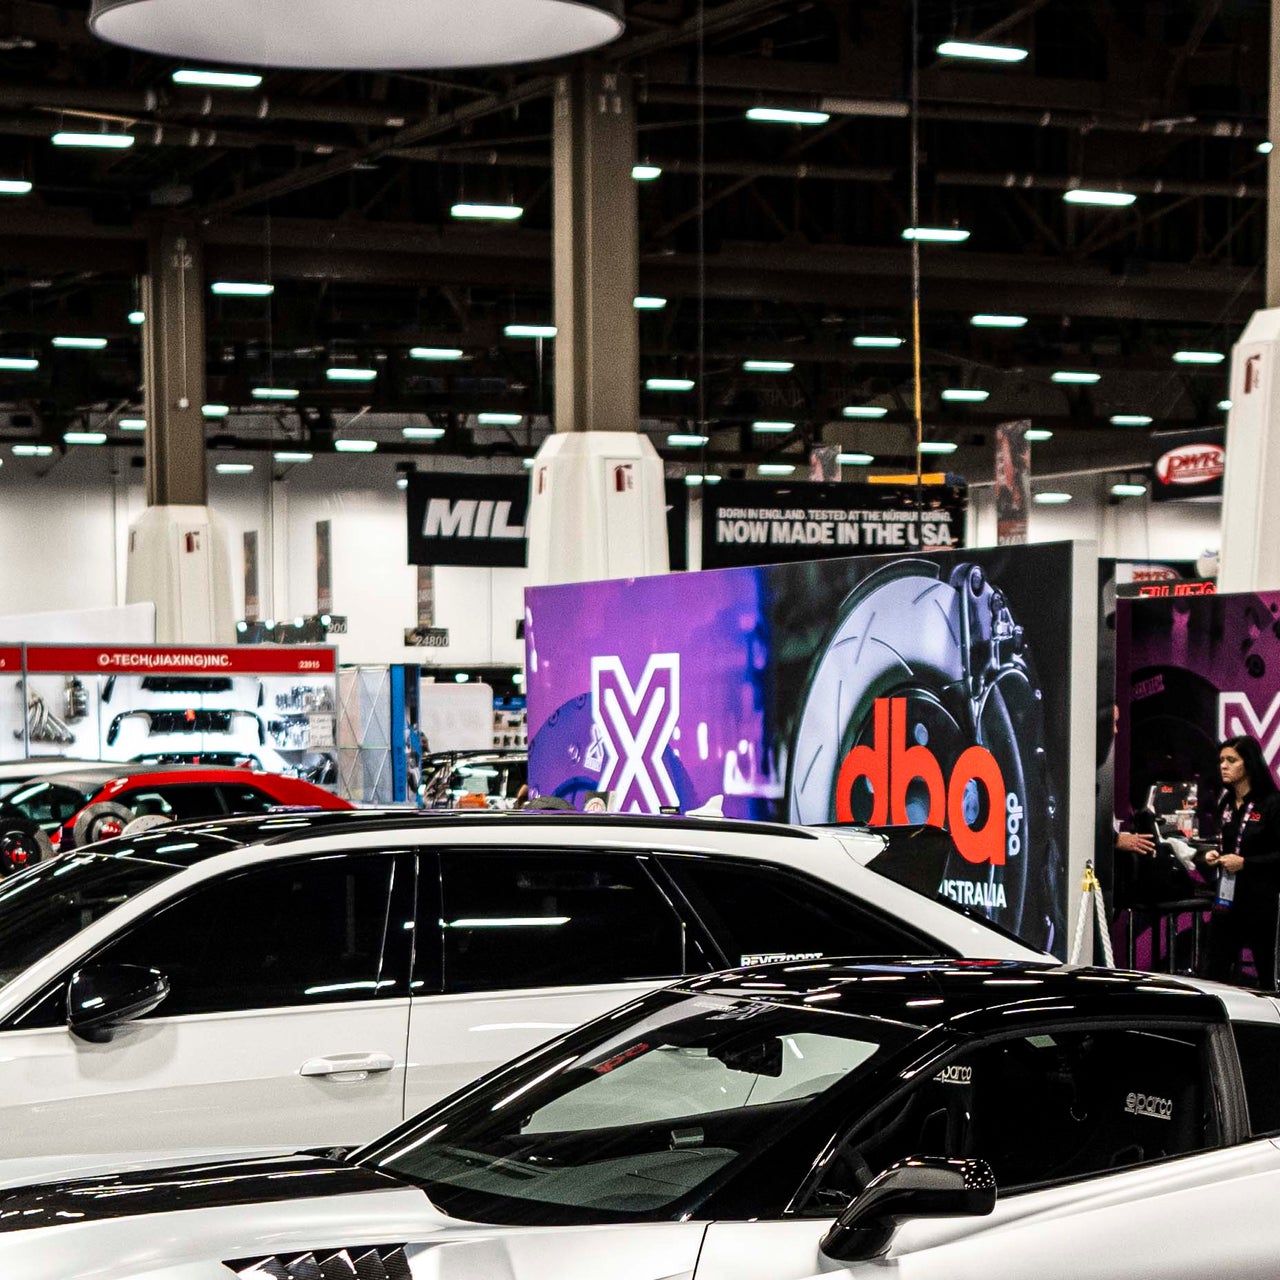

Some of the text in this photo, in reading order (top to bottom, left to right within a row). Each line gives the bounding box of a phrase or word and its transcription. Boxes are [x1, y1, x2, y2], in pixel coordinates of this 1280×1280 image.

[423, 498, 533, 539] MIL
[718, 508, 747, 519] BORN
[748, 509, 759, 519] IN
[760, 509, 808, 520] ENGLAND.
[808, 509, 847, 521] TESTED
[848, 510, 860, 521] AT
[861, 510, 881, 521] THE
[718, 520, 952, 546] NOW MADE IN THE USA
[97, 653, 233, 668] O-TECH(JIAXING)INC.
[835, 697, 1006, 865] dba
[1006, 792, 1023, 856] dba
[934, 1065, 972, 1084] parco
